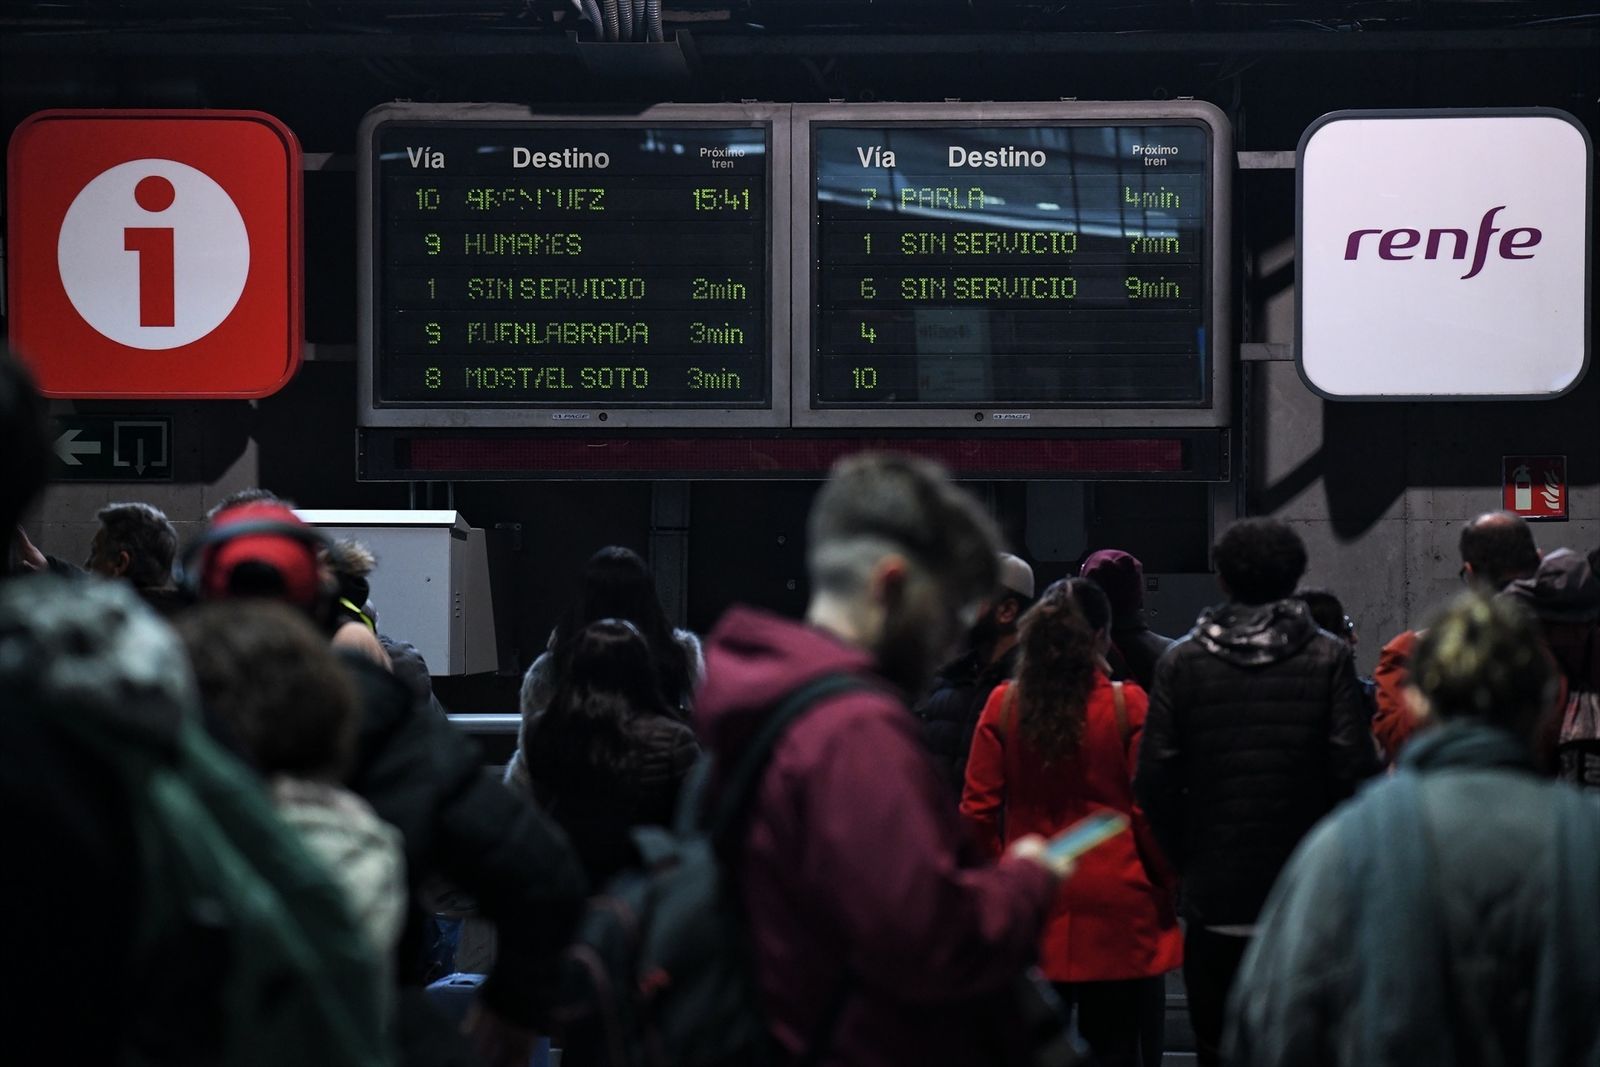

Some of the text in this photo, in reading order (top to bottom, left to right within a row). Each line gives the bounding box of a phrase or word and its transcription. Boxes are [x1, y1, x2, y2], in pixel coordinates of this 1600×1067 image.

[406, 146, 611, 169] Vía Destino
[699, 146, 746, 158] Próximo
[857, 146, 1047, 168] Vía Destino
[1132, 143, 1179, 156] Próximo
[711, 158, 734, 169] tren
[1144, 156, 1167, 167] tren
[415, 188, 441, 210] 10
[692, 188, 750, 211] 15:41
[860, 186, 1180, 209] 7 PARLA 4min
[424, 233, 583, 255] 9 HUMANES
[863, 231, 1180, 254] 1 SIN SERVICIO 7min
[1343, 205, 1543, 281] renfe
[427, 277, 747, 300] 1 SIN SERVICIO 2min
[860, 276, 1180, 299] 6 SIN SERVICIO 9min
[467, 322, 649, 344] FUENLABRADA
[689, 322, 744, 344] 3min
[859, 321, 877, 344] 4
[424, 366, 741, 389] 8 MOST/EL SOTO 3min
[852, 367, 877, 389] 10
